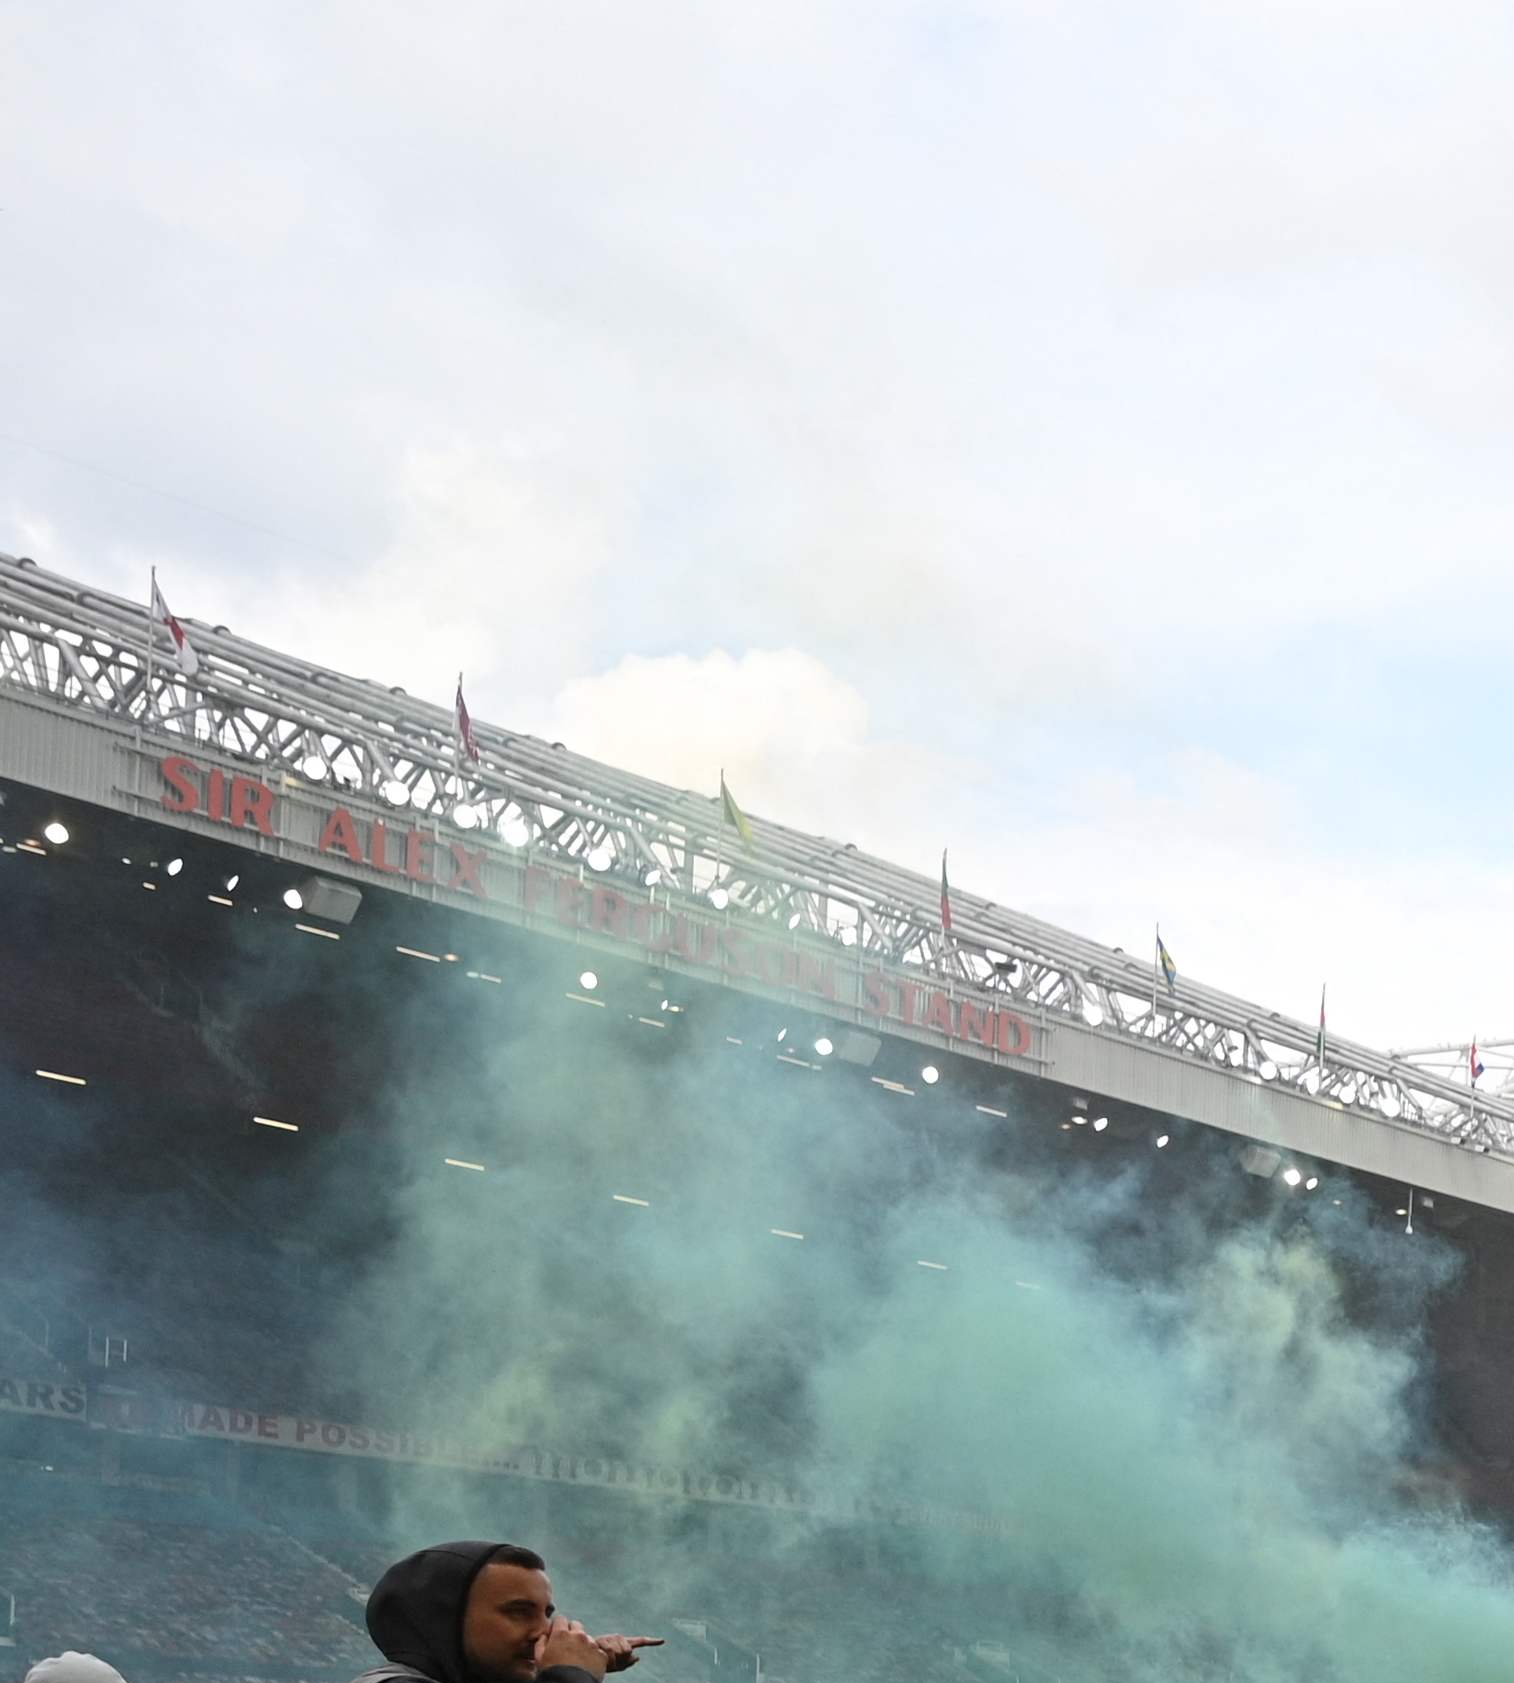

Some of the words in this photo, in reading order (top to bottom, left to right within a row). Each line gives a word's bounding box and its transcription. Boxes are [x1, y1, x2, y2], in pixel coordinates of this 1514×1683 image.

[160, 756, 275, 838] SIR
[319, 807, 488, 898] ALEX
[864, 970, 1032, 1056] STAND
